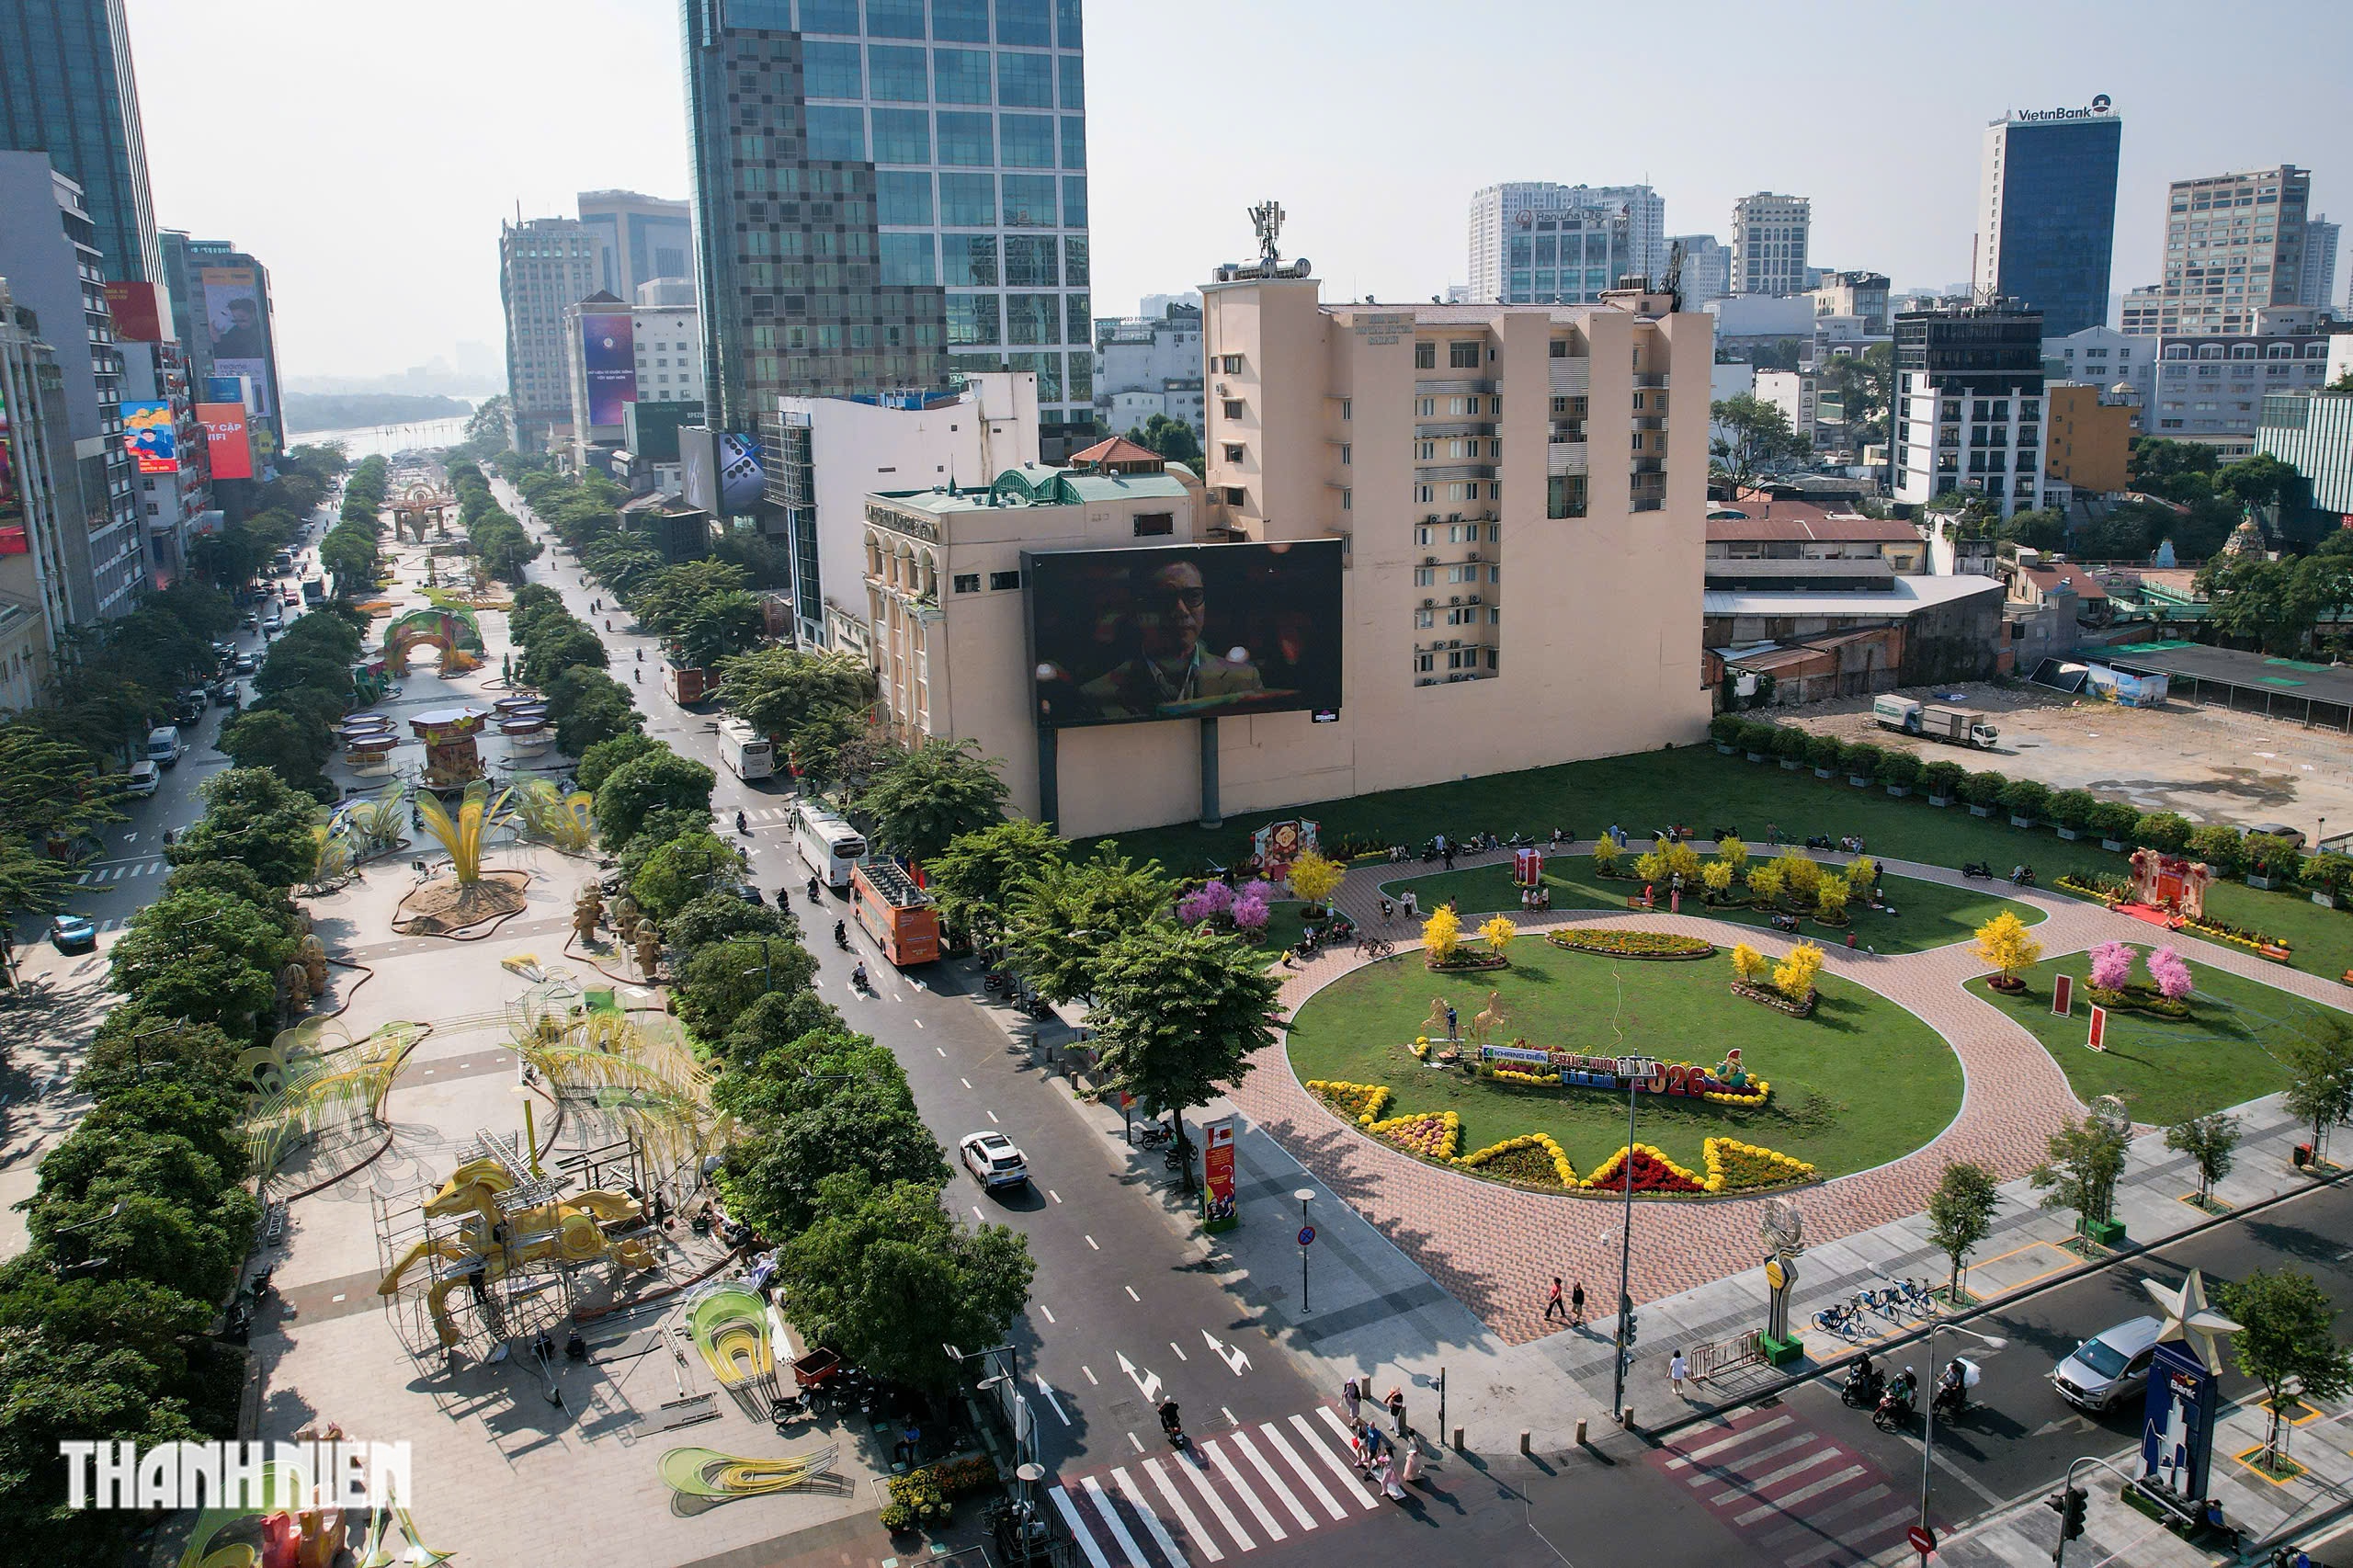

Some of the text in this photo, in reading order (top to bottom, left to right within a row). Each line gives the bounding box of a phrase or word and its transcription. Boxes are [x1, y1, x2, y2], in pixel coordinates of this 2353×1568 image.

[2018, 107, 2092, 120] VietinBank
[1536, 211, 1580, 222] Hanwha
[1495, 1050, 1525, 1059] KHANG
[2170, 1379, 2197, 1400] Bank
